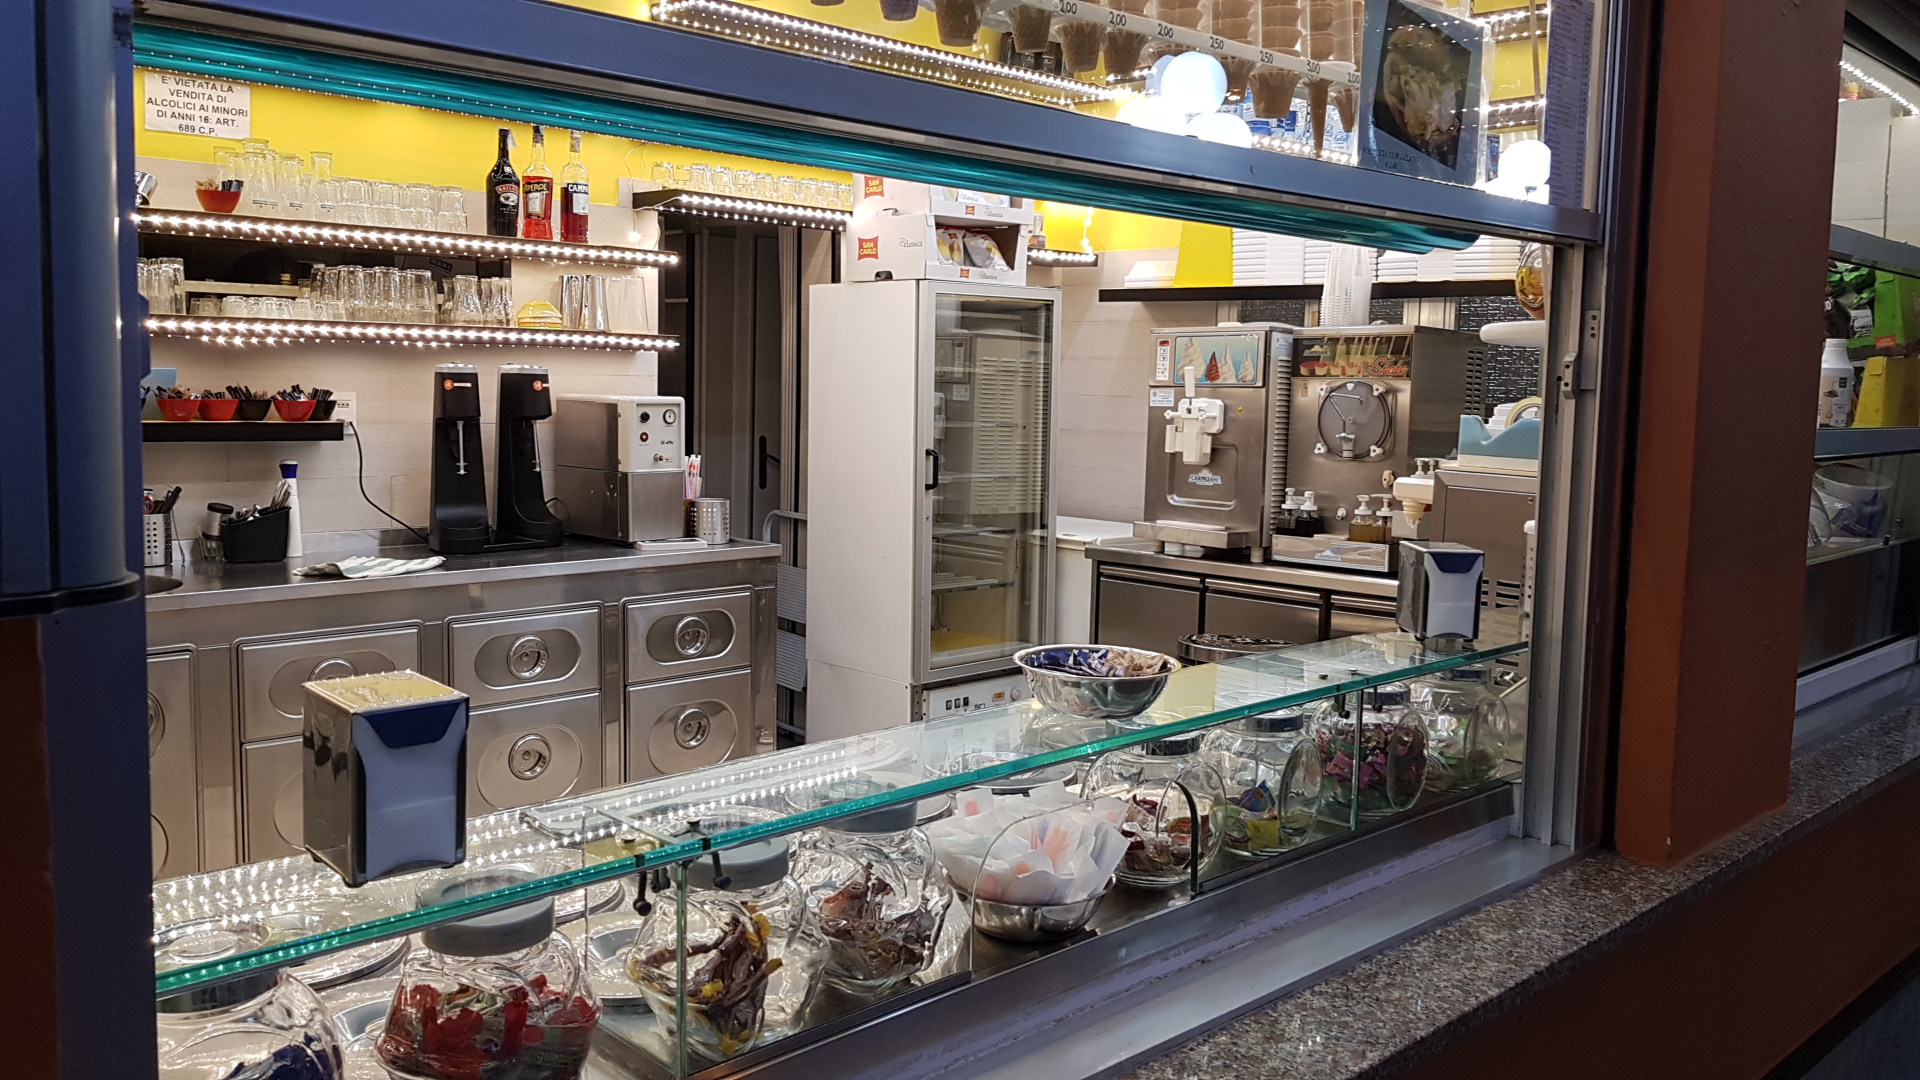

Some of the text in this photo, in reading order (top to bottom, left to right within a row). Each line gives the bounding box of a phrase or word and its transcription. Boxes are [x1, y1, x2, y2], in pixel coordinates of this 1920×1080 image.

[1060, 0, 1078, 14] 2,00
[1109, 11, 1126, 26] 2,00
[1157, 23, 1174, 38] 2,00
[1210, 36, 1224, 50] 2,50
[1259, 50, 1273, 64] 2,50
[1306, 59, 1320, 74] 3,00
[174, 77, 218, 91] VIETATA
[220, 84, 234, 93] LA
[1347, 72, 1360, 84] 2,00
[169, 88, 227, 103] VENDITA DI
[146, 97, 248, 117] ALCOLICI AI MINORI
[156, 109, 167, 118] DI
[170, 111, 195, 122] ANNI
[215, 117, 239, 128] ART.
[178, 123, 218, 136] 689 C.P.
[524, 183, 548, 192] APEROL
[865, 185, 883, 193] CARLO
[868, 179, 880, 187] SAN
[859, 247, 877, 255] CARLO
[862, 241, 874, 249] SAN
